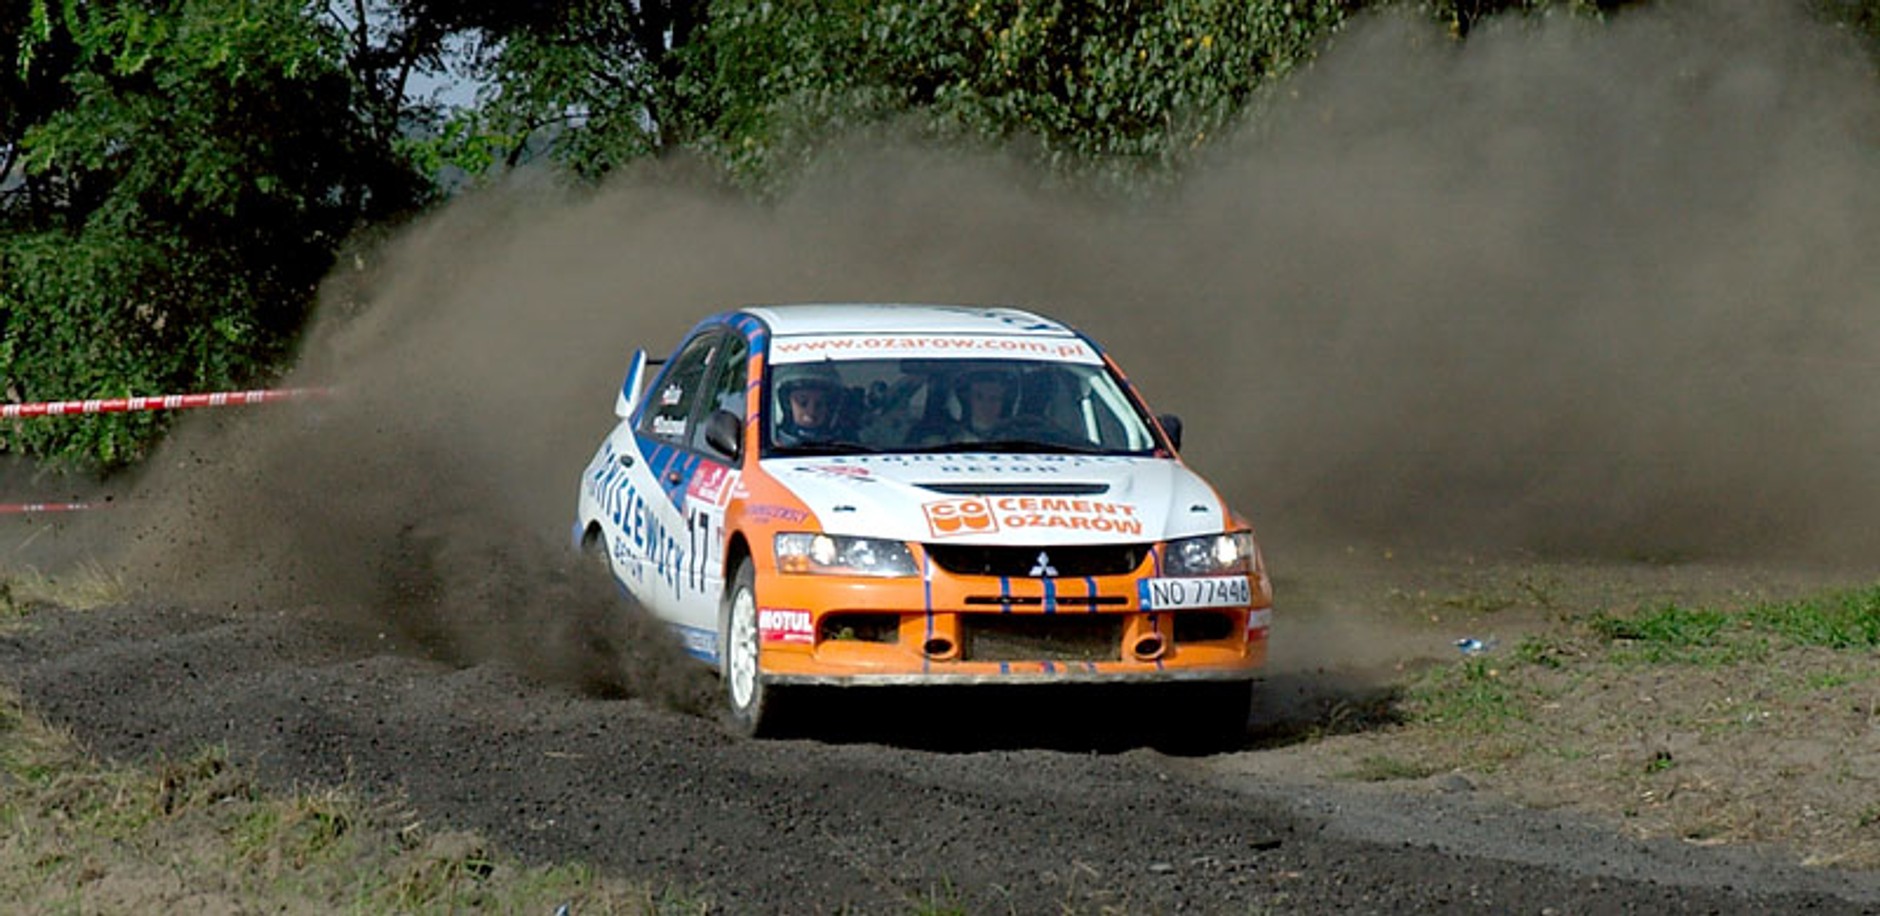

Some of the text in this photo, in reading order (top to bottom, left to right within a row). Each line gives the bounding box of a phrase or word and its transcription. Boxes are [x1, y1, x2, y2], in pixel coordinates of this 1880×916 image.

[776, 335, 1086, 358] www.ozarow.com.pl
[997, 497, 1137, 516] CEMENT
[687, 507, 709, 593] 17
[1153, 580, 1186, 606] NO
[759, 609, 812, 632] MOTUL
